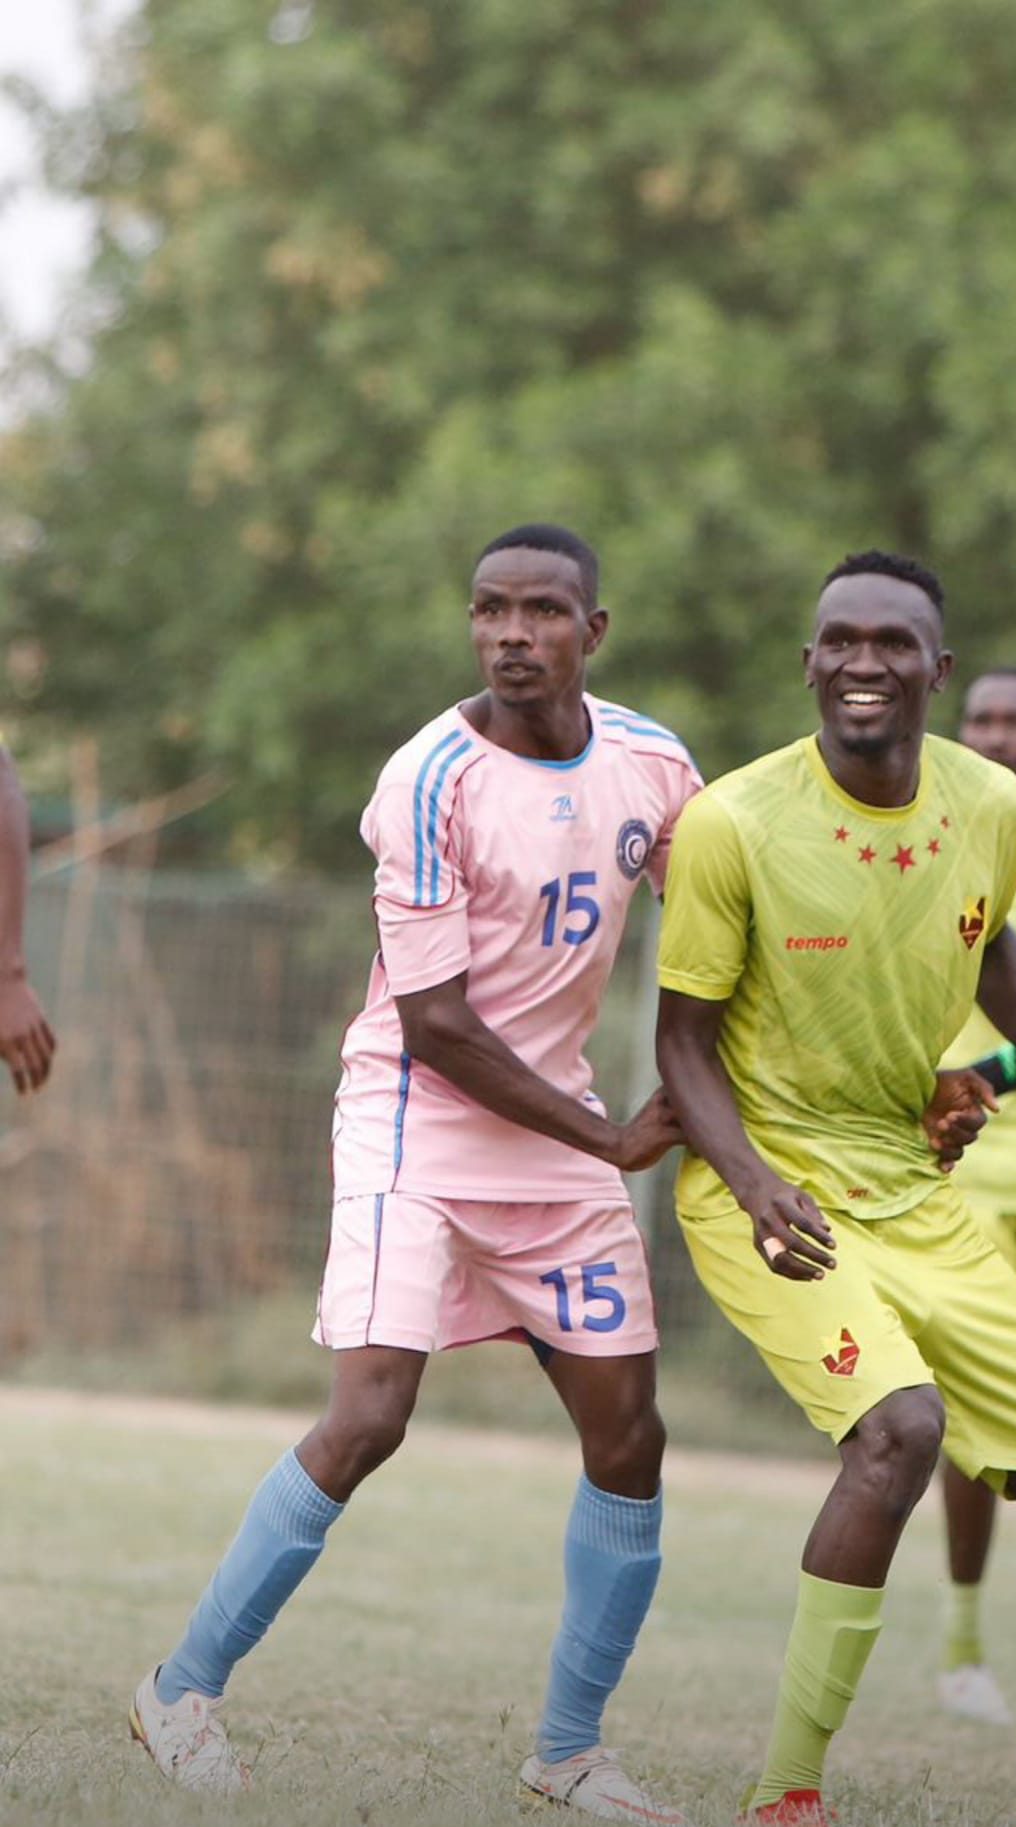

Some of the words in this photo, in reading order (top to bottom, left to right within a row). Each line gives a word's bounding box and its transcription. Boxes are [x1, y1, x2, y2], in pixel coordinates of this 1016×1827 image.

[540, 871, 599, 946] 15
[786, 936, 848, 951] tempo
[539, 1262, 626, 1333] 15
